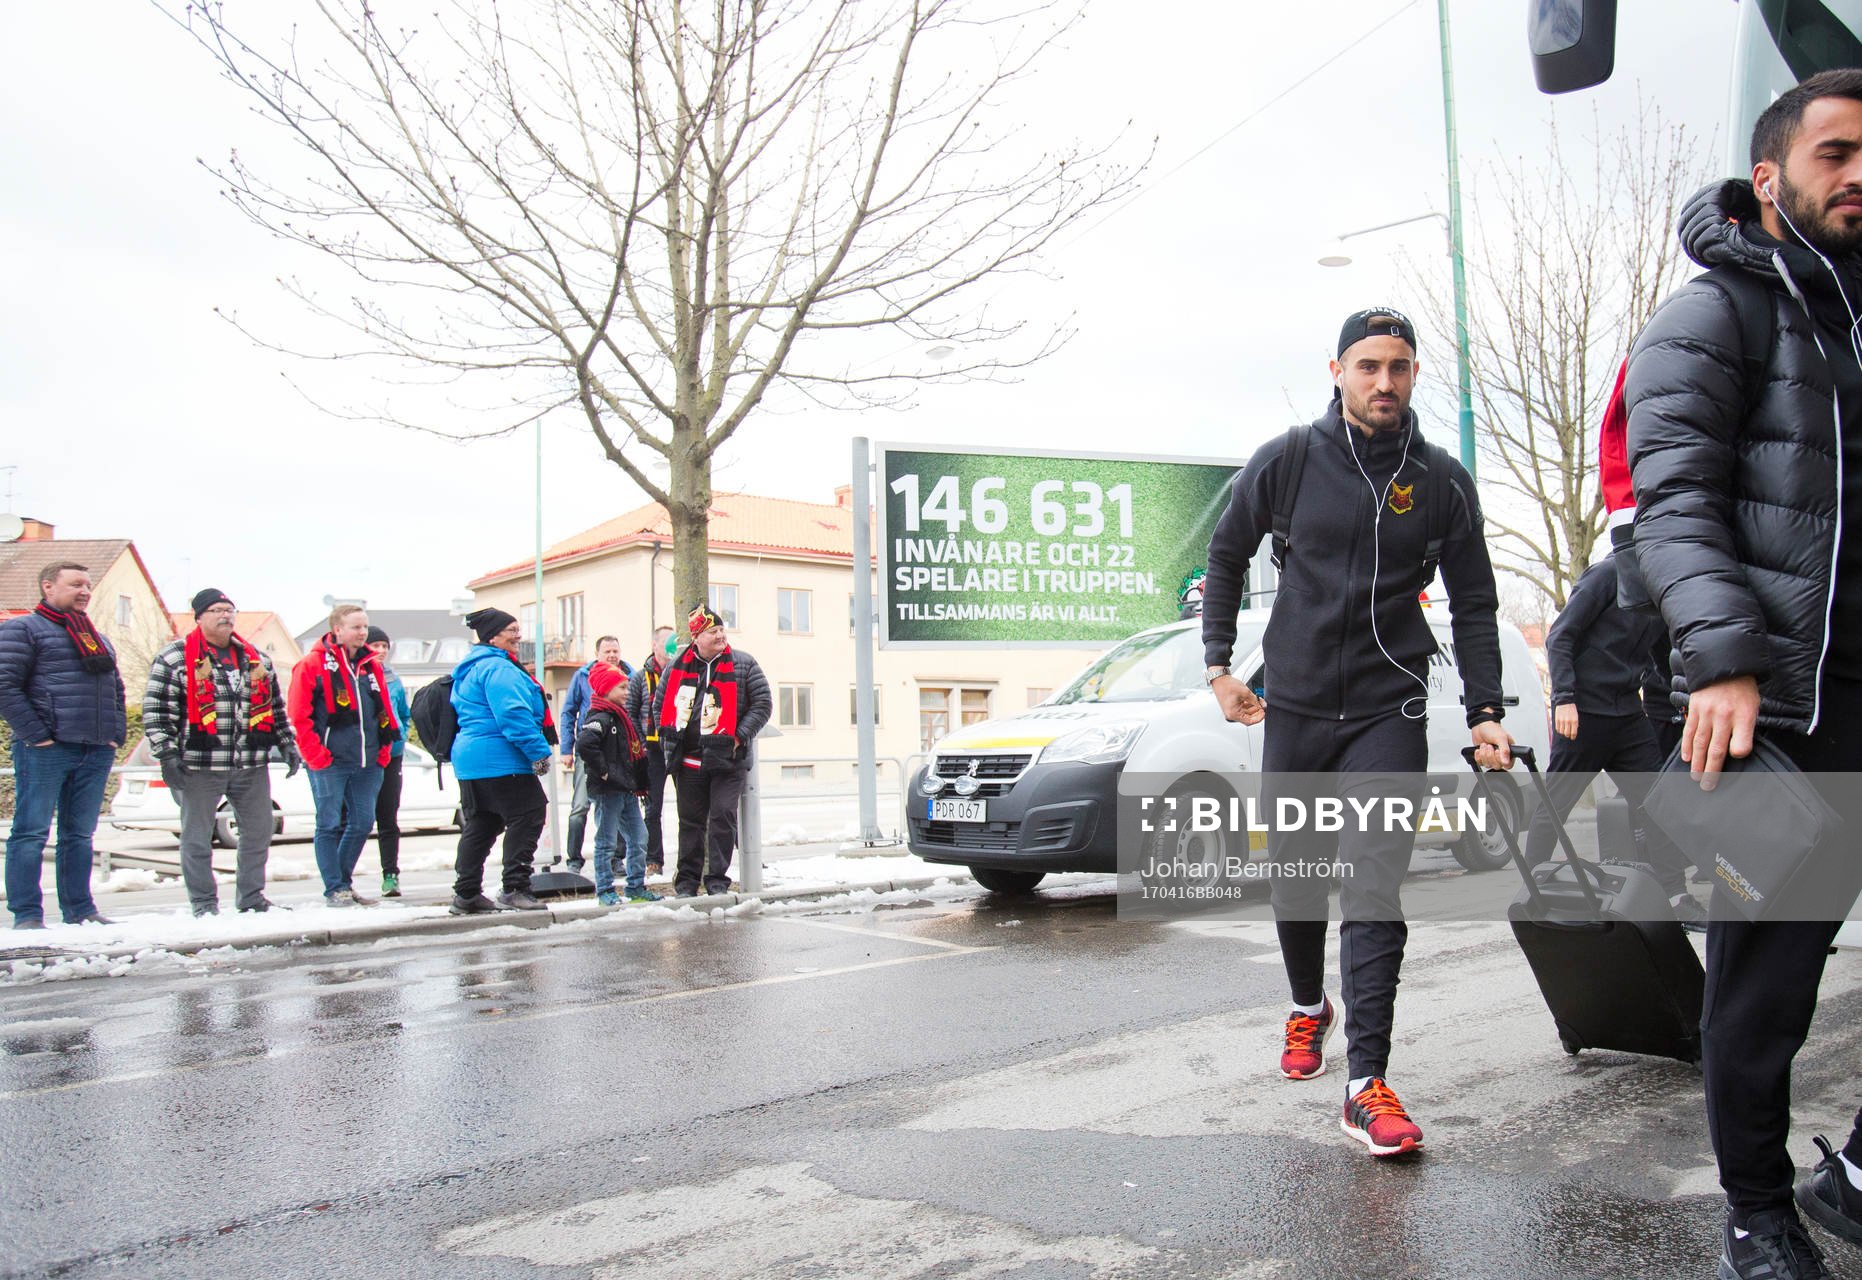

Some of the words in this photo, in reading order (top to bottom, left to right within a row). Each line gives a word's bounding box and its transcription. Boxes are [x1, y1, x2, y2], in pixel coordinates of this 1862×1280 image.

[890, 474, 1009, 536] 146
[1030, 479, 1134, 538] 631
[895, 533, 1041, 565] INVÅNARE
[1049, 541, 1099, 567] OCH
[1106, 545, 1135, 567] 22
[895, 566, 1018, 593] SPELARE
[1023, 569, 1030, 593] I
[1033, 569, 1161, 594] TRUPPEN.
[896, 603, 1026, 621] TILLSAMMANS
[1029, 601, 1054, 622] ÄR
[1057, 605, 1075, 622] VI
[1078, 606, 1120, 623] ALLT.
[935, 802, 955, 819] PDR
[958, 802, 980, 819] 067
[1715, 853, 1764, 901] VEINOPLUS
[1715, 866, 1751, 901] SPORT
